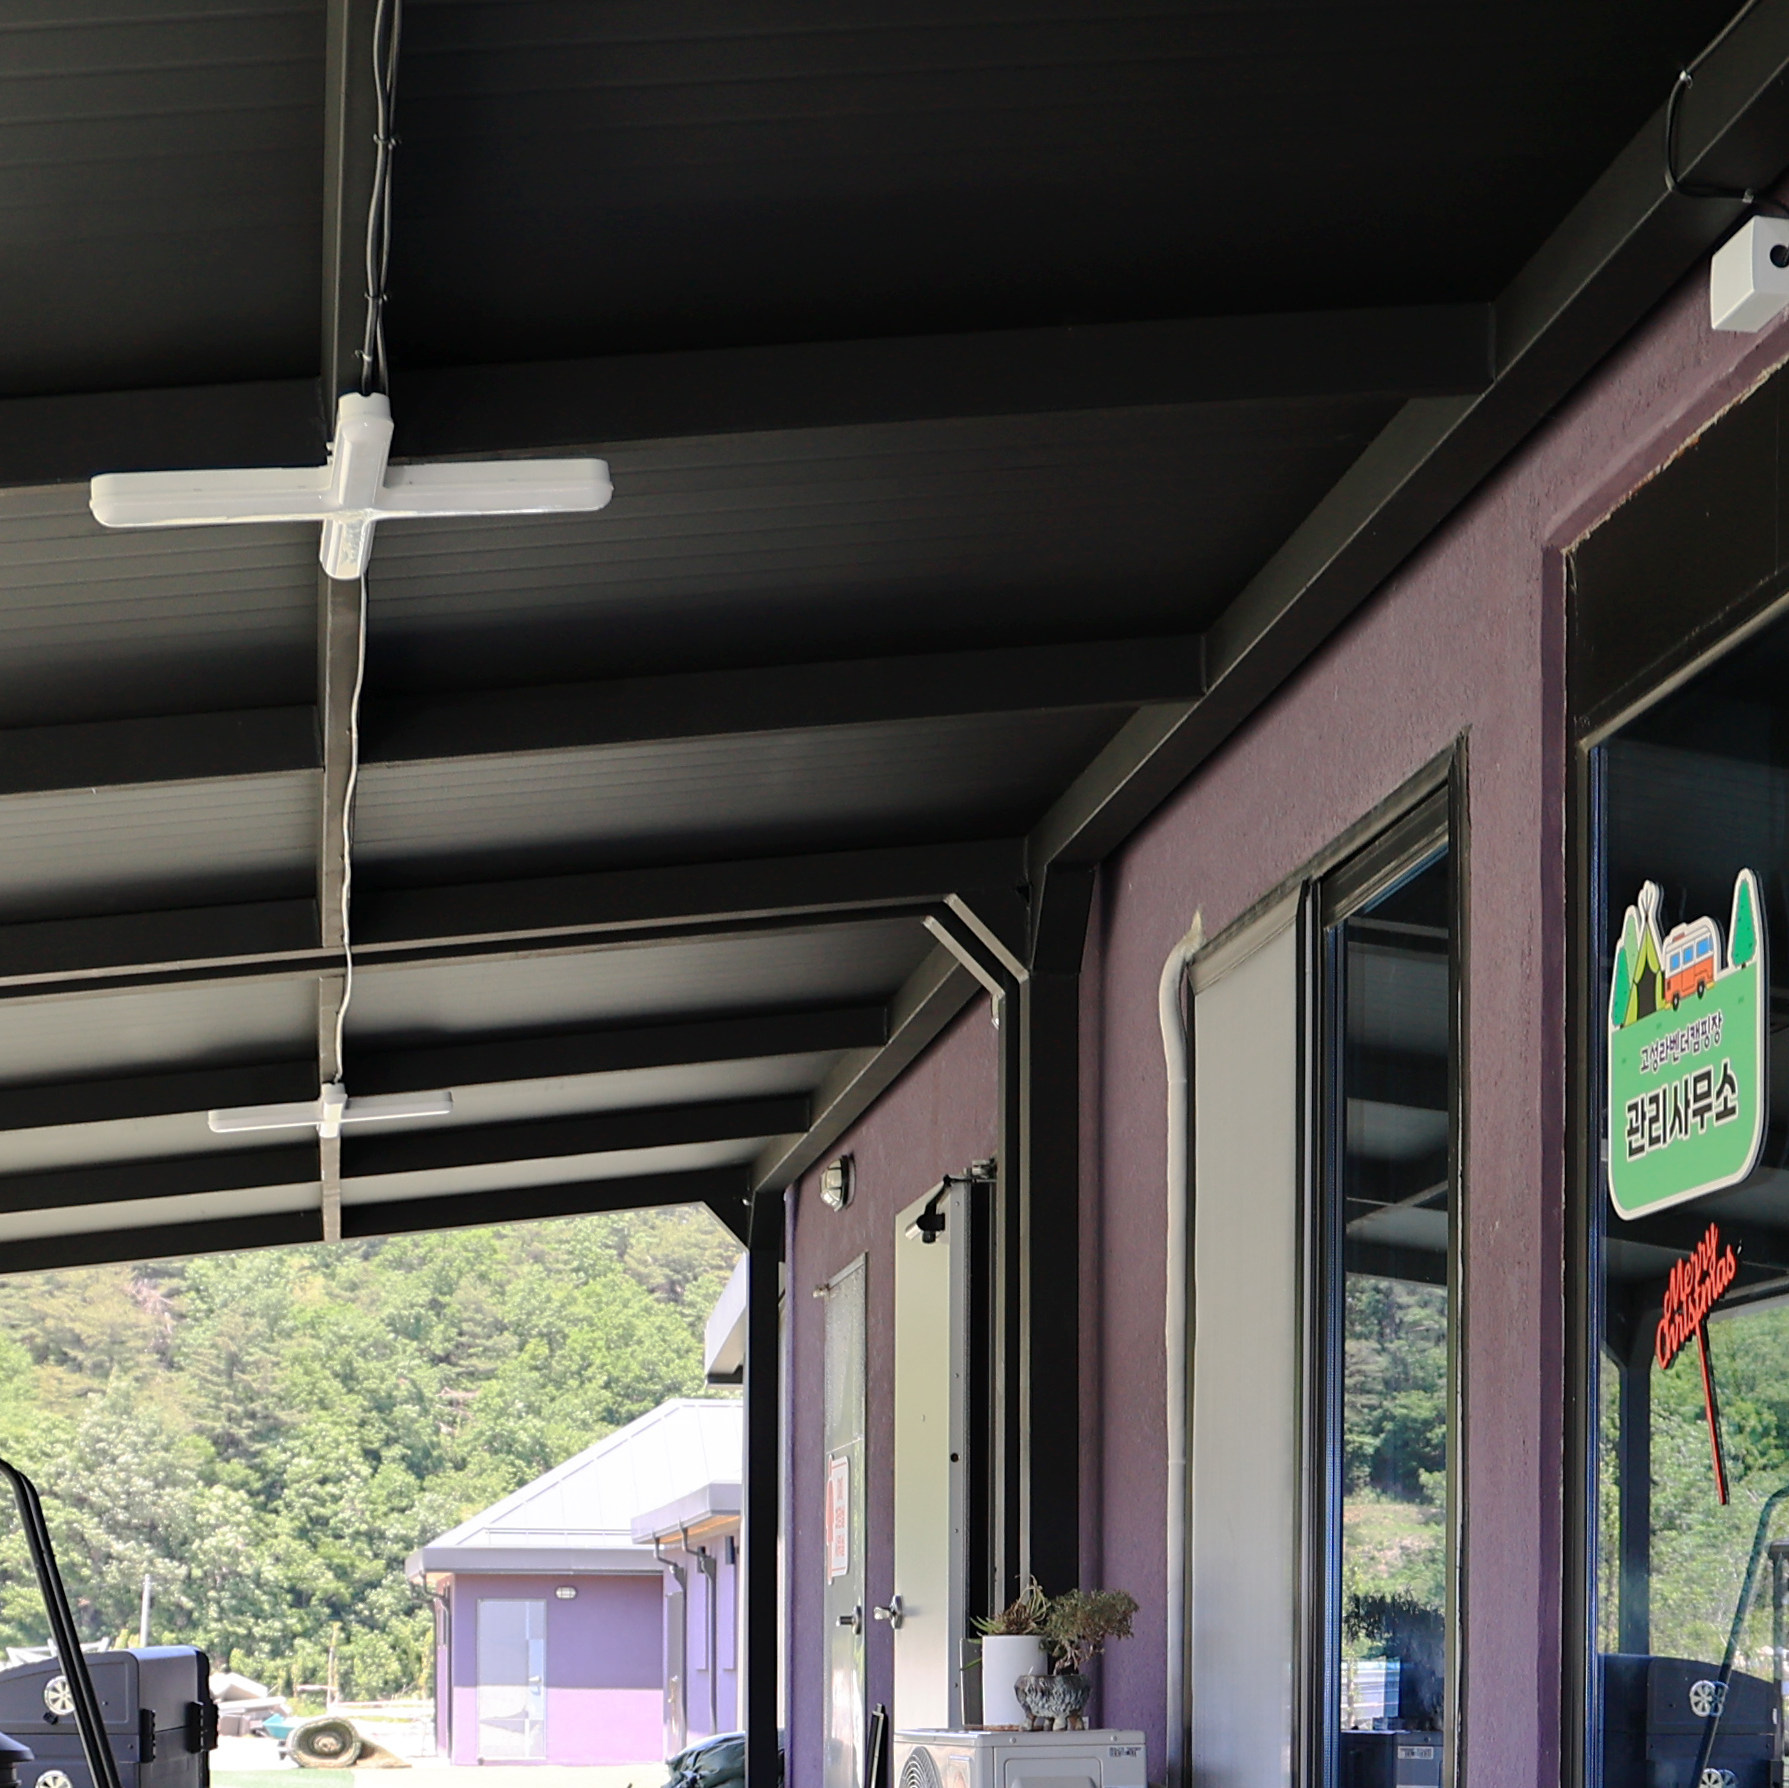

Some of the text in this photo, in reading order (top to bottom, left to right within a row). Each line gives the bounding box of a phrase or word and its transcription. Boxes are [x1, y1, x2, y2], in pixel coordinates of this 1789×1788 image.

[1640, 1010, 1723, 1073] 고성라벤더캠핑장
[1626, 1060, 1738, 1160] 관리사무소
[1655, 1243, 1737, 1370] Christmas
[1664, 1221, 1720, 1321] Merry
